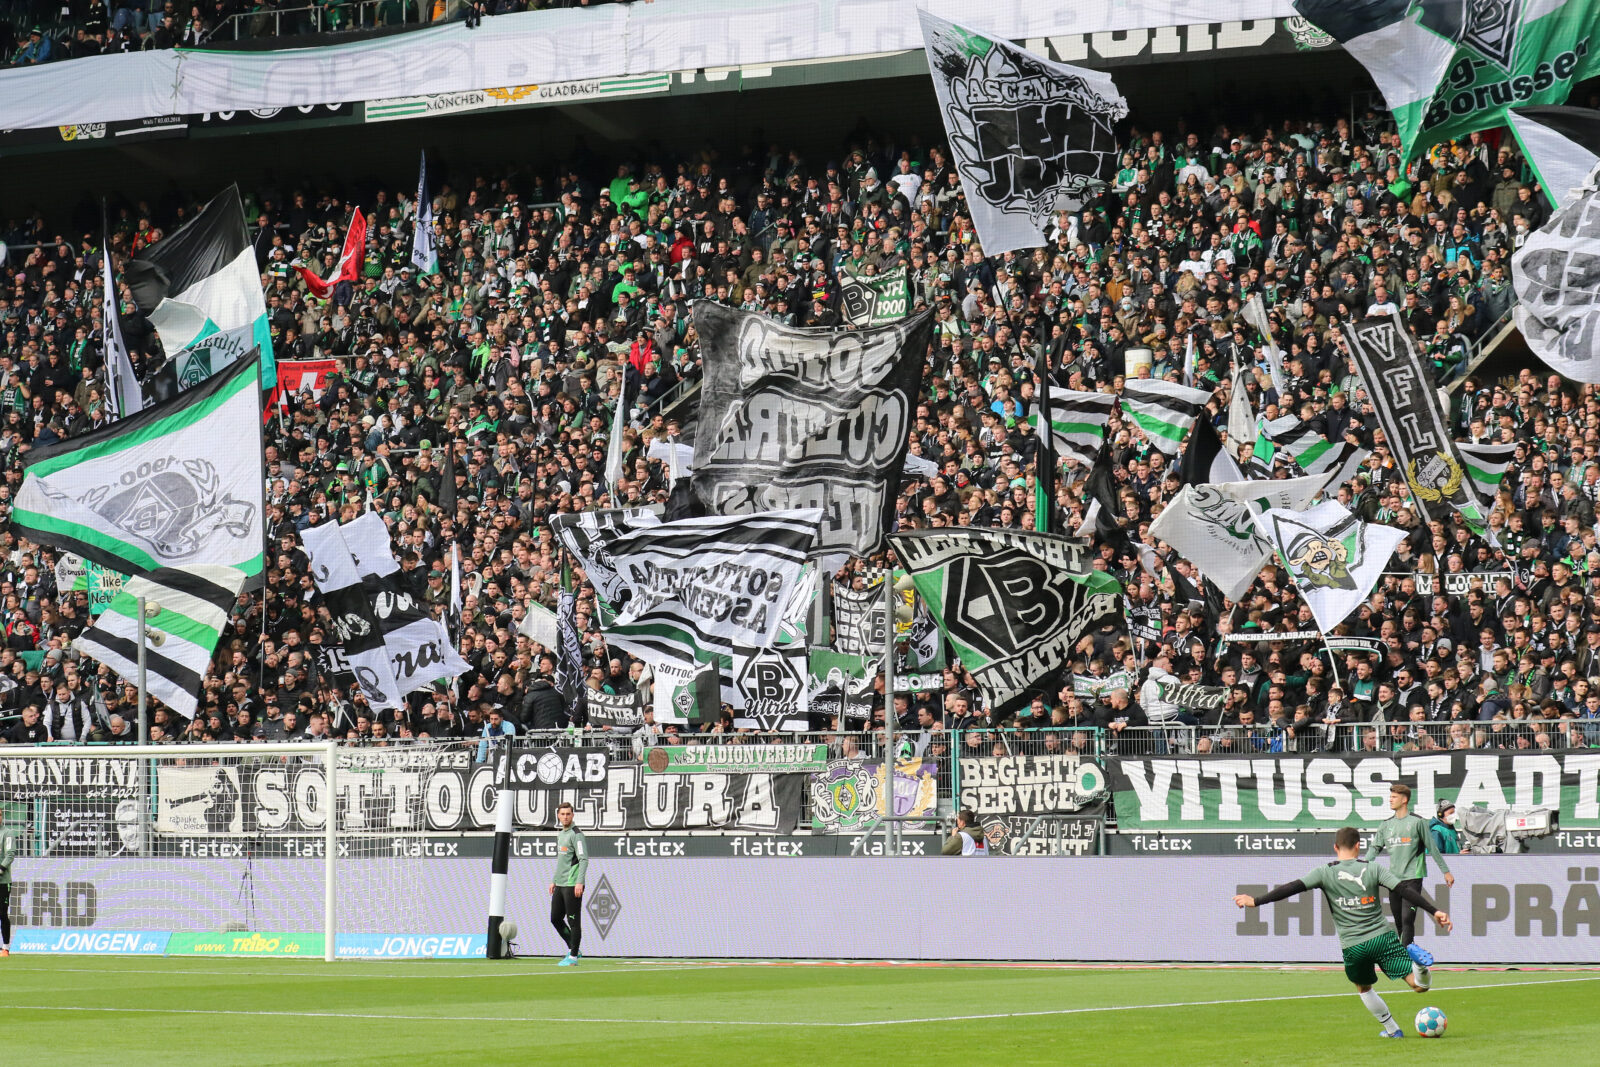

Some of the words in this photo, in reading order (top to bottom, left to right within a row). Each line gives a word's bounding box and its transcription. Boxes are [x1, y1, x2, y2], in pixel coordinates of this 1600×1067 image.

[1423, 36, 1590, 132] Borusser
[426, 93, 485, 112] MÖNCHEN
[539, 82, 600, 99] GLADBACH
[877, 299, 906, 316] 1900
[980, 532, 1087, 573] MACHT
[102, 576, 121, 588] like
[588, 687, 635, 706] SOTTO
[744, 697, 799, 718] Ultras
[685, 744, 817, 764] STADIONVERBOT
[960, 755, 1080, 788] BEGLEIT
[960, 782, 1076, 814] SERVICE
[180, 839, 243, 857] flatex
[284, 838, 350, 857] flatx
[391, 838, 459, 857] flatex
[614, 837, 686, 857] flatex
[730, 837, 804, 857] flatex
[1132, 835, 1192, 851] flatex
[1234, 834, 1297, 851] flatex
[1335, 895, 1377, 907] flatex
[51, 932, 142, 952] JONGEN
[373, 936, 473, 956] JONGEN
